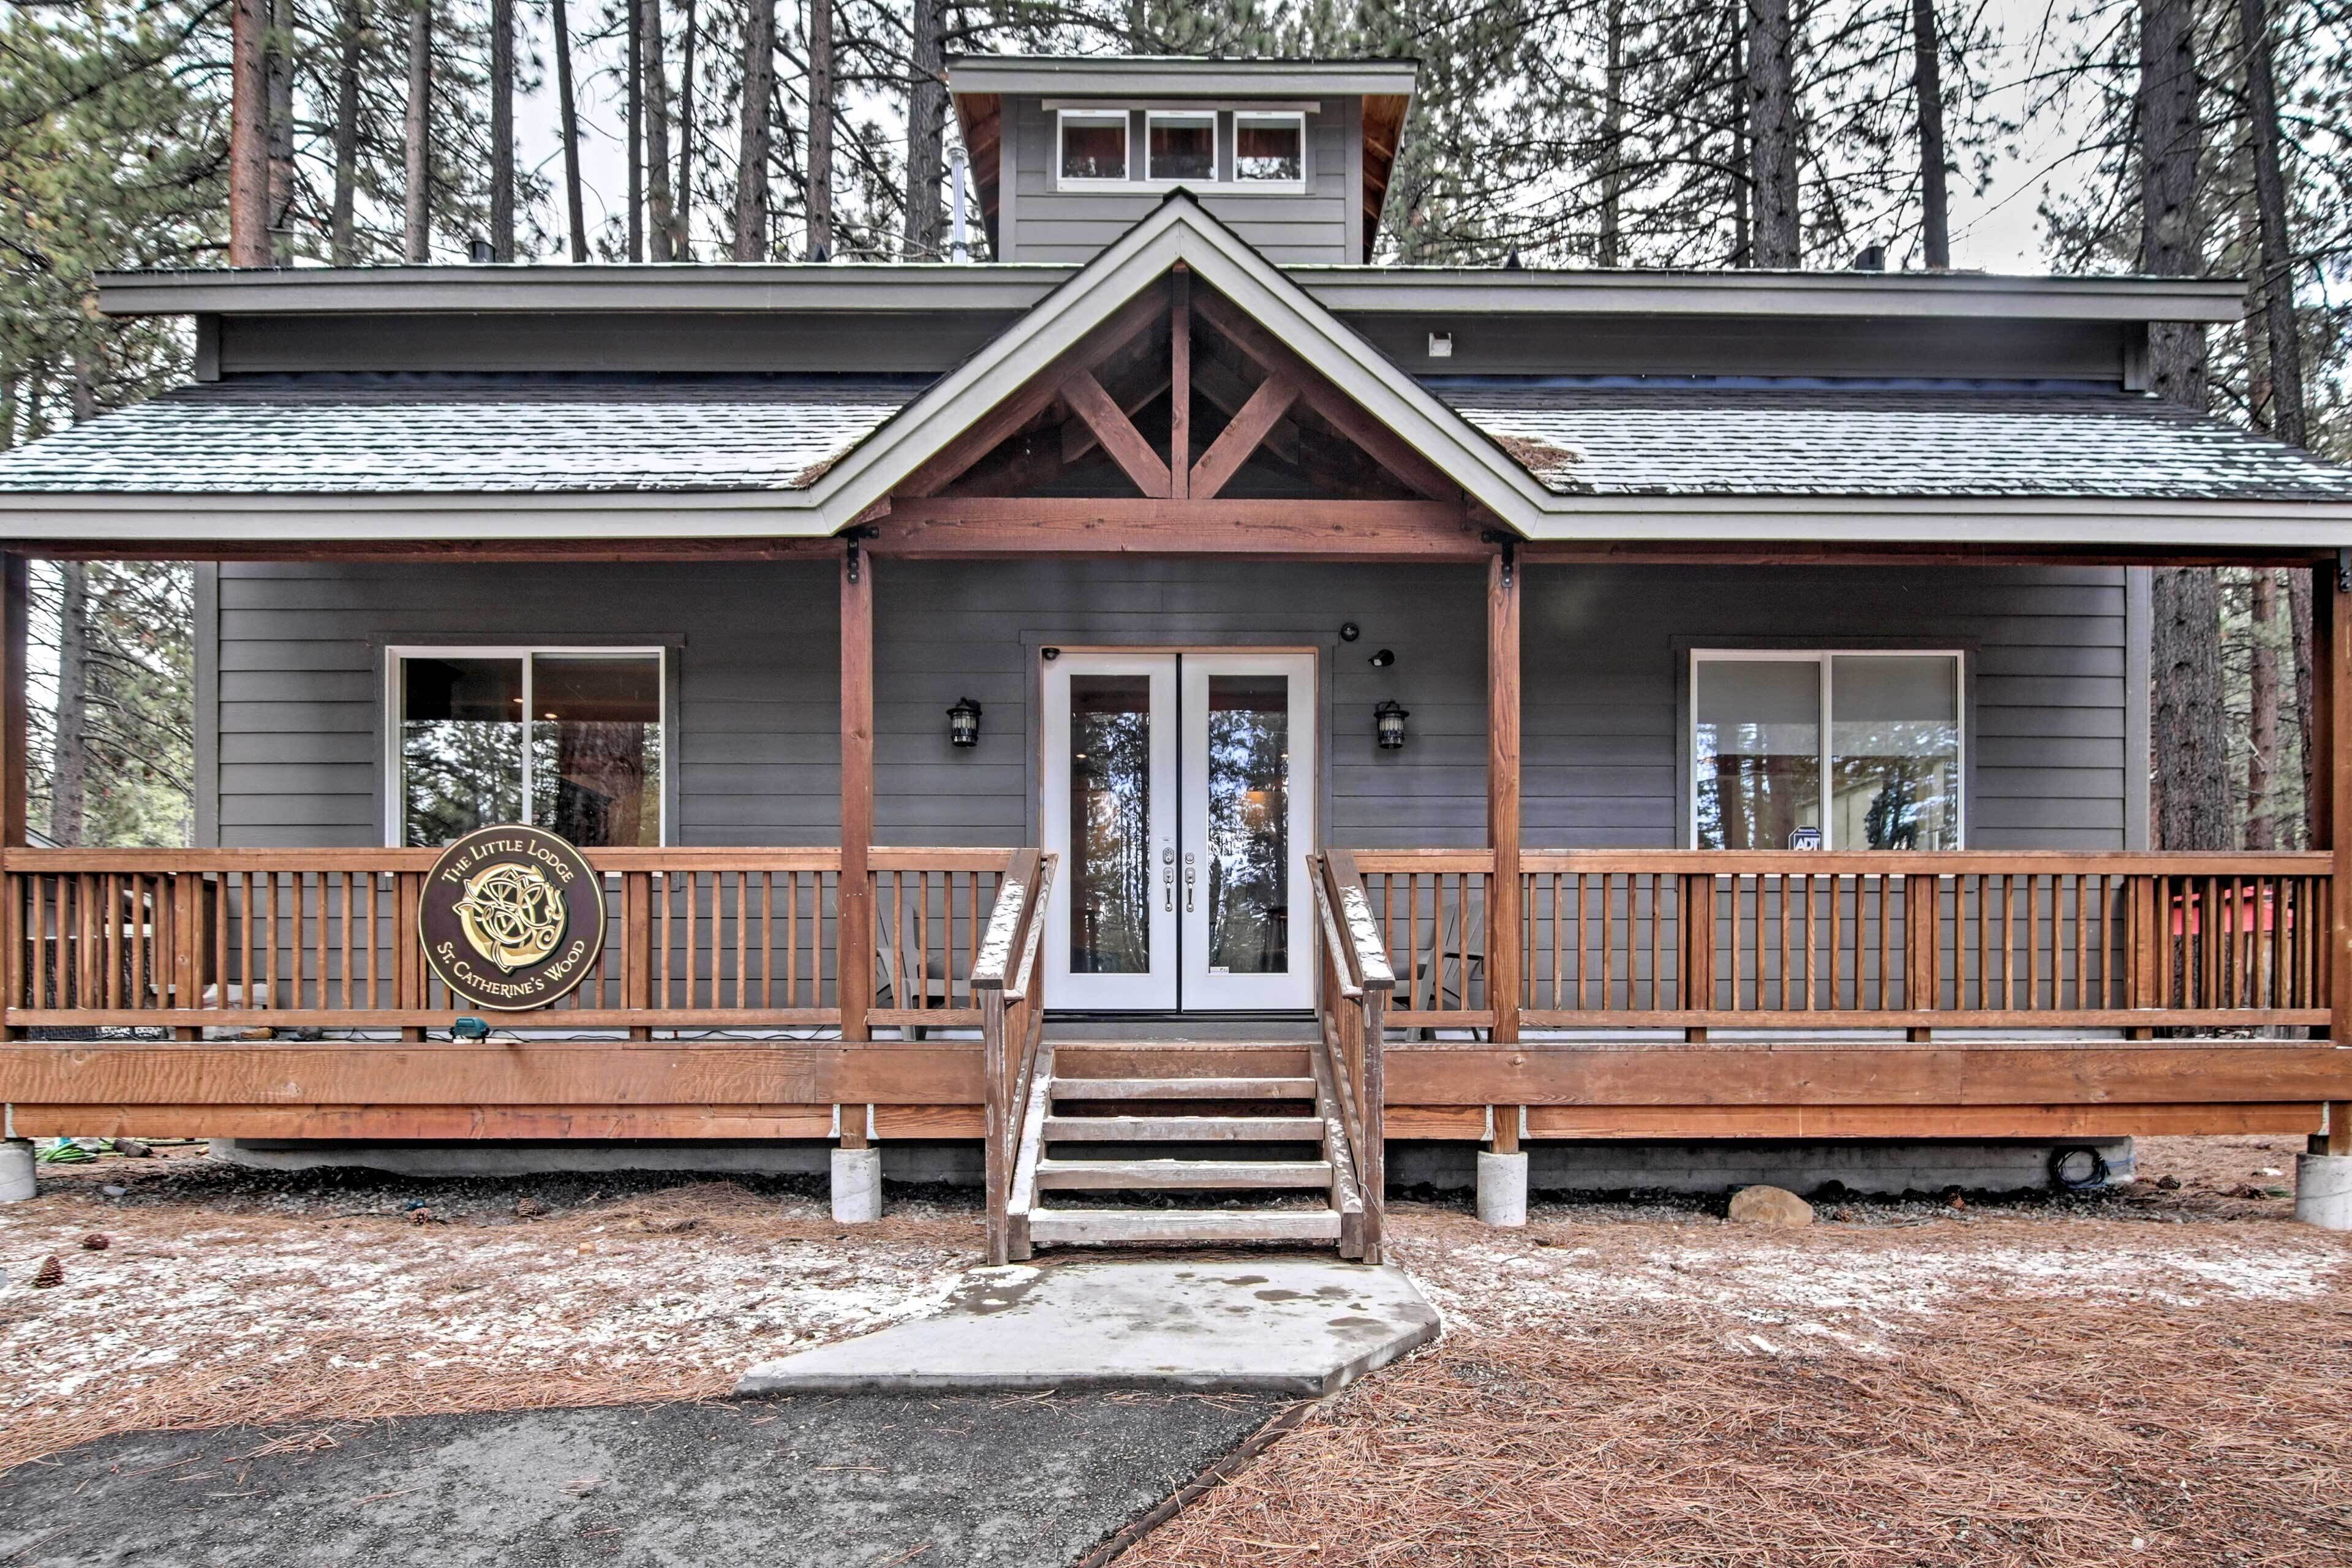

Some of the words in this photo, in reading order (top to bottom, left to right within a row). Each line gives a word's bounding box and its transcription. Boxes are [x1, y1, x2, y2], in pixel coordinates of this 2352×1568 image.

[442, 857, 471, 882] THE
[469, 840, 523, 860] LITTLE
[527, 839, 574, 883] LODGE
[1795, 837, 1819, 851] ADT
[545, 940, 584, 981] WOOD
